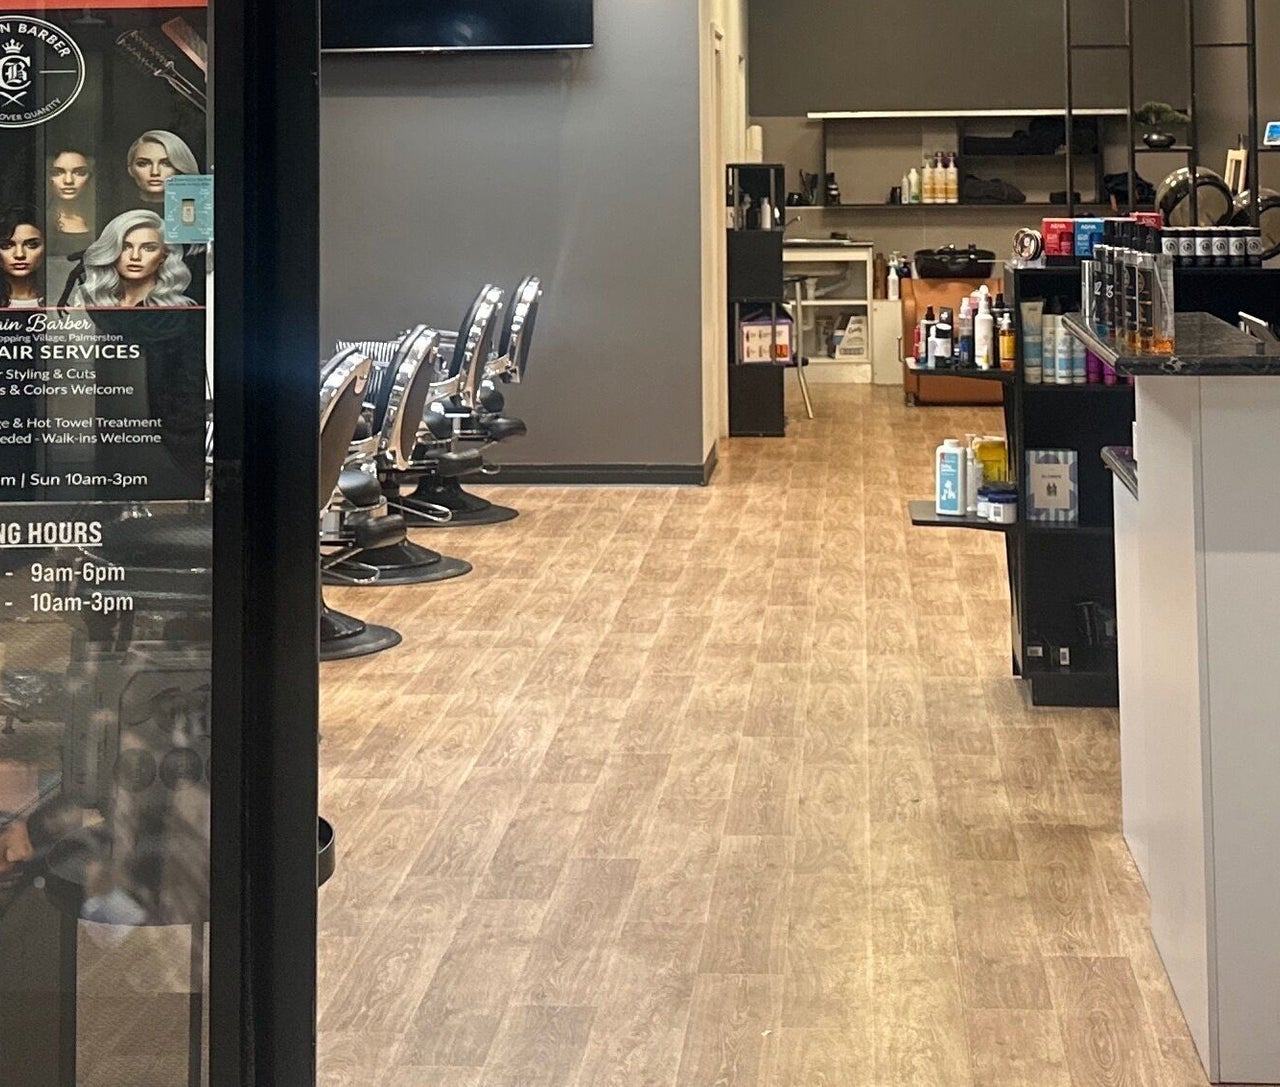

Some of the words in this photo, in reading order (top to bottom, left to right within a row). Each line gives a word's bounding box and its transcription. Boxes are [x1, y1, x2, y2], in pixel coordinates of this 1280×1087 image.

[17, 22, 71, 59] BARBER
[23, 96, 63, 121] QUANTITY
[25, 313, 92, 332] Barber
[68, 332, 124, 342] Palmerston
[40, 344, 141, 360] SERVICES
[5, 368, 51, 381] Styling
[53, 368, 63, 379] &
[66, 368, 96, 379] Cuts
[9, 384, 20, 395] &
[23, 383, 68, 396] Colors
[70, 383, 134, 396] Welcome
[12, 418, 23, 429] &
[26, 417, 53, 429] Hot
[54, 417, 93, 429] Towel
[95, 416, 163, 429] Treatment
[42, 432, 98, 445] Walk-ins
[100, 431, 163, 444] Welcome
[29, 473, 61, 487] Sun
[64, 472, 148, 489] 10am-3pm
[27, 521, 103, 545] HOURS
[30, 562, 126, 584] 9am-6pm
[30, 592, 134, 614] 10am-3pm
